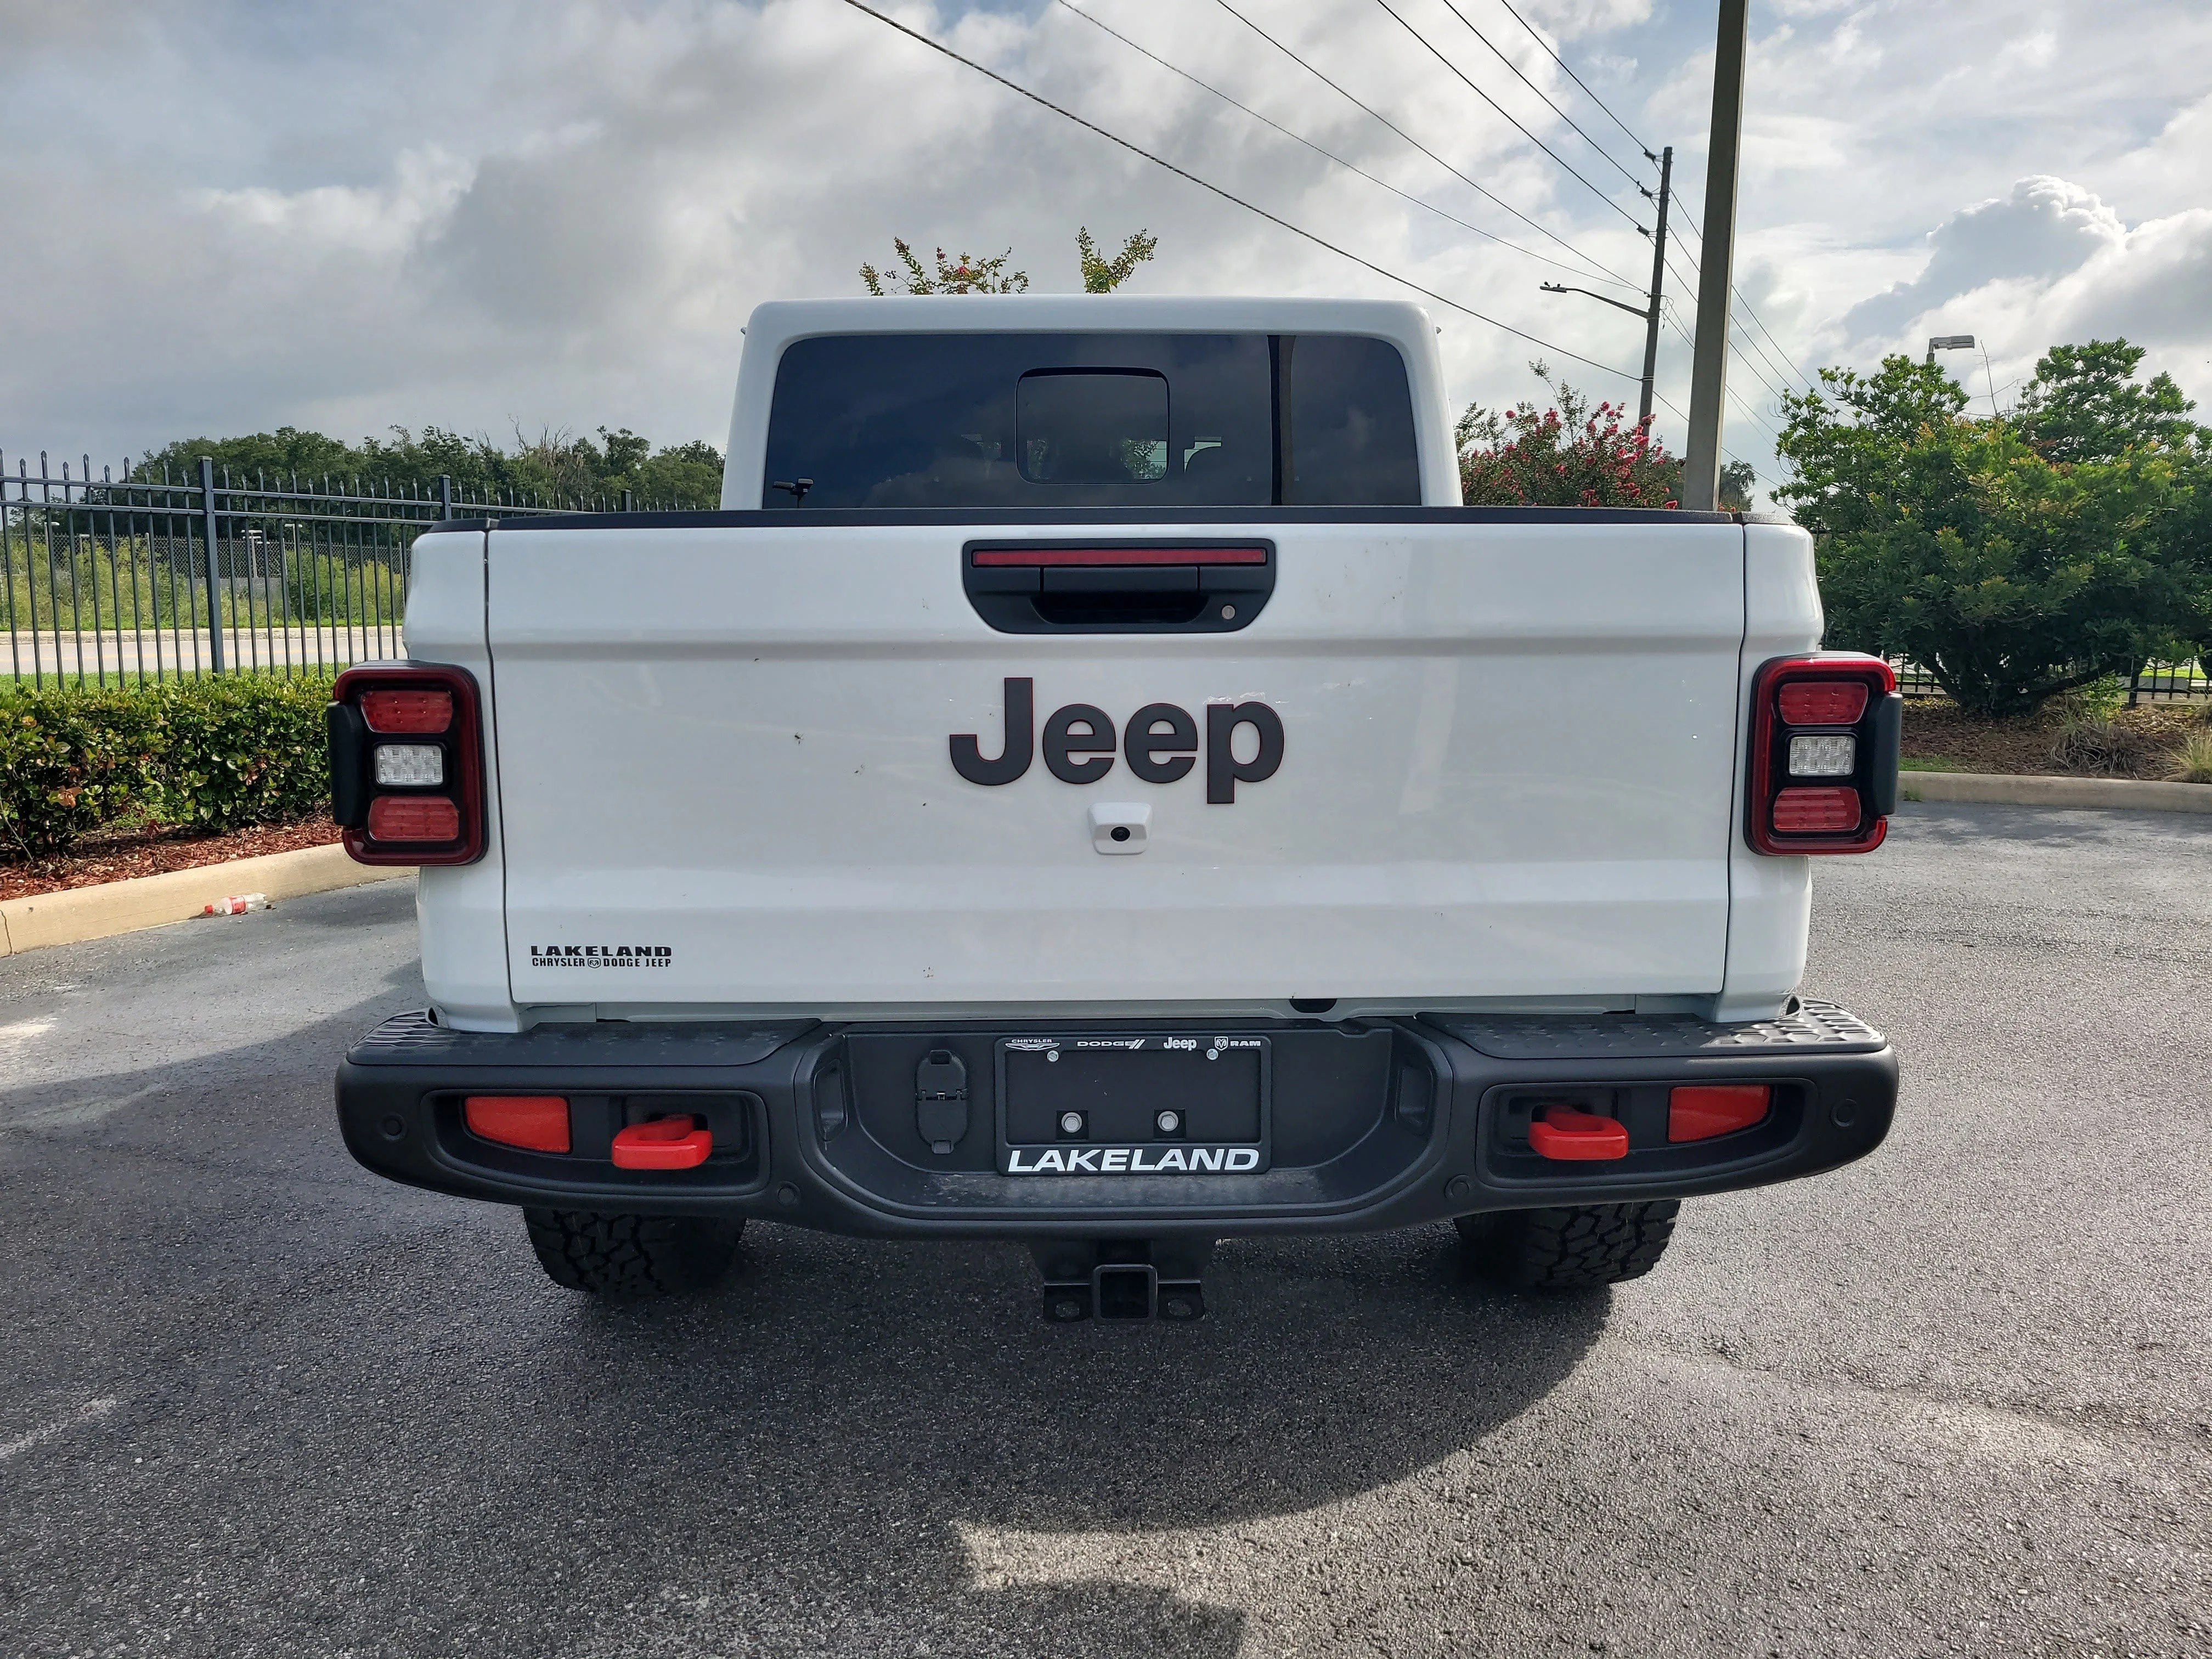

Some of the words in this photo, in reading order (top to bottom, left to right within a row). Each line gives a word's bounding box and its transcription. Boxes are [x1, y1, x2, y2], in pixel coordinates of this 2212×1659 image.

[949, 677, 1284, 804] Jeep
[531, 945, 672, 957] LAKELAND
[532, 957, 585, 967] CHRYSLER
[603, 958, 641, 967] DODGE
[645, 958, 672, 967] JEEP
[1163, 1036, 1197, 1051] Jeep
[1008, 1148, 1260, 1172] LAKELAND
